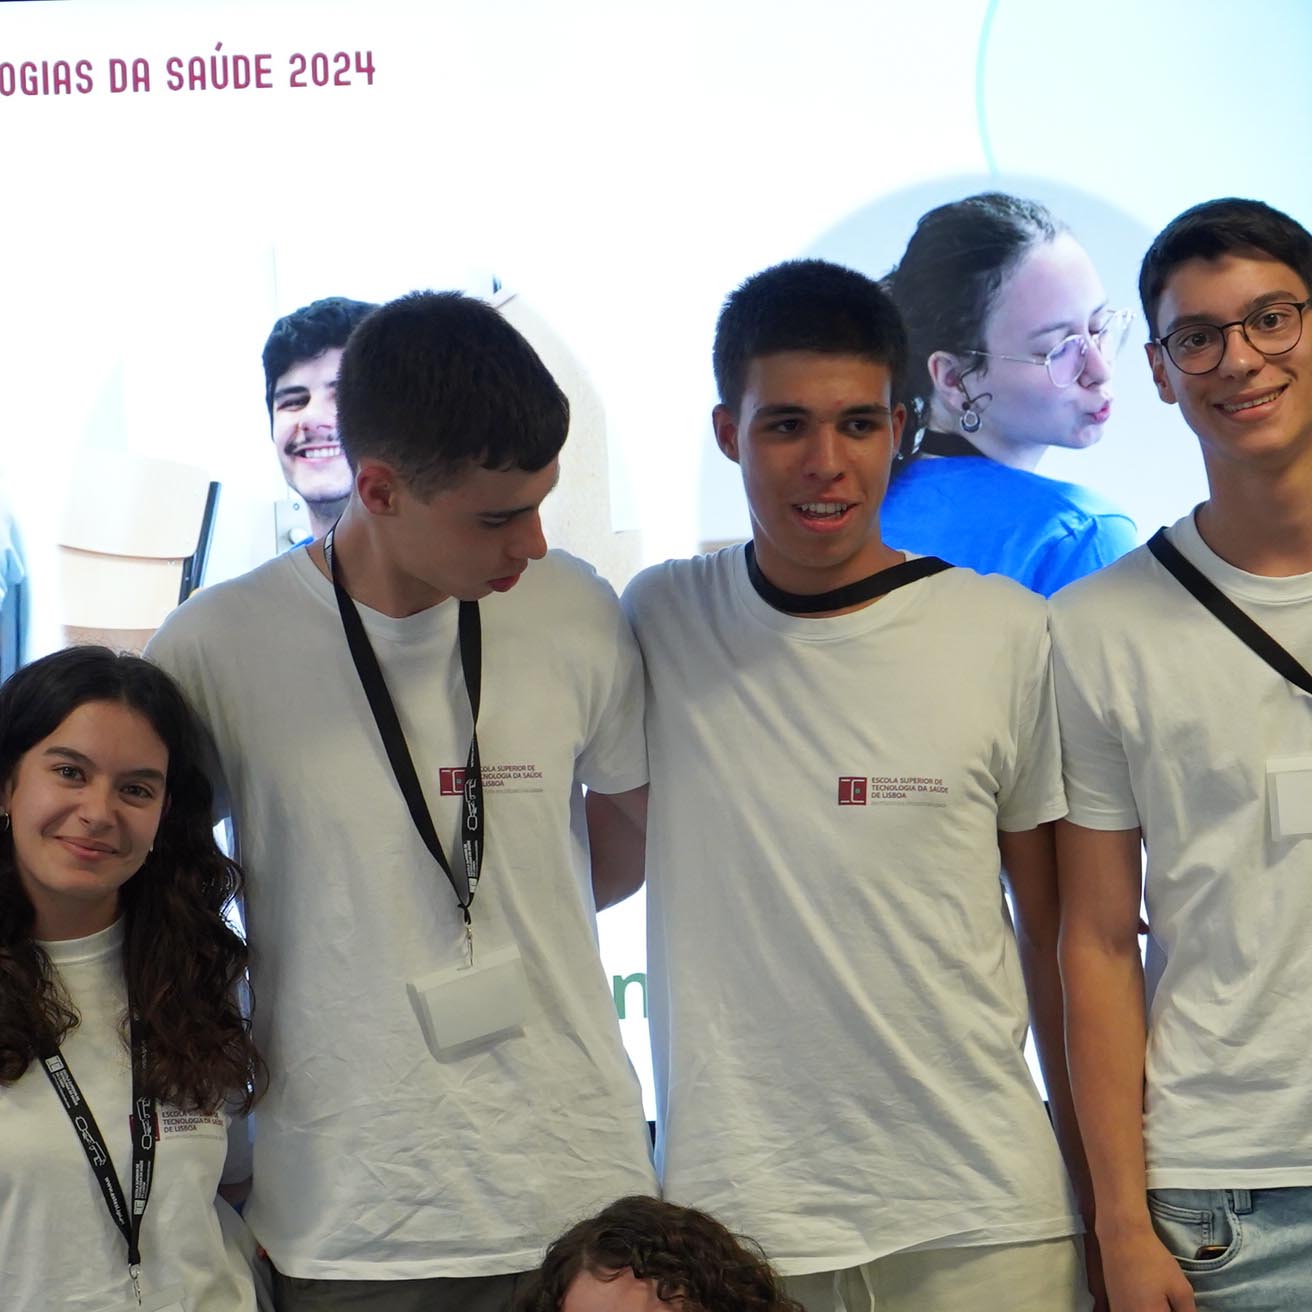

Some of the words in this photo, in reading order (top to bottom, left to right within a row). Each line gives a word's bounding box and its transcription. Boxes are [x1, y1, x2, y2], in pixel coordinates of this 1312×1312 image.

[109, 58, 151, 94] DA
[166, 43, 272, 91] SAÚDE
[289, 51, 376, 88] 2024
[871, 777, 899, 785] ESCOLA
[900, 777, 934, 785] SUPERIOR
[871, 784, 917, 793] TECNOLOGIA
